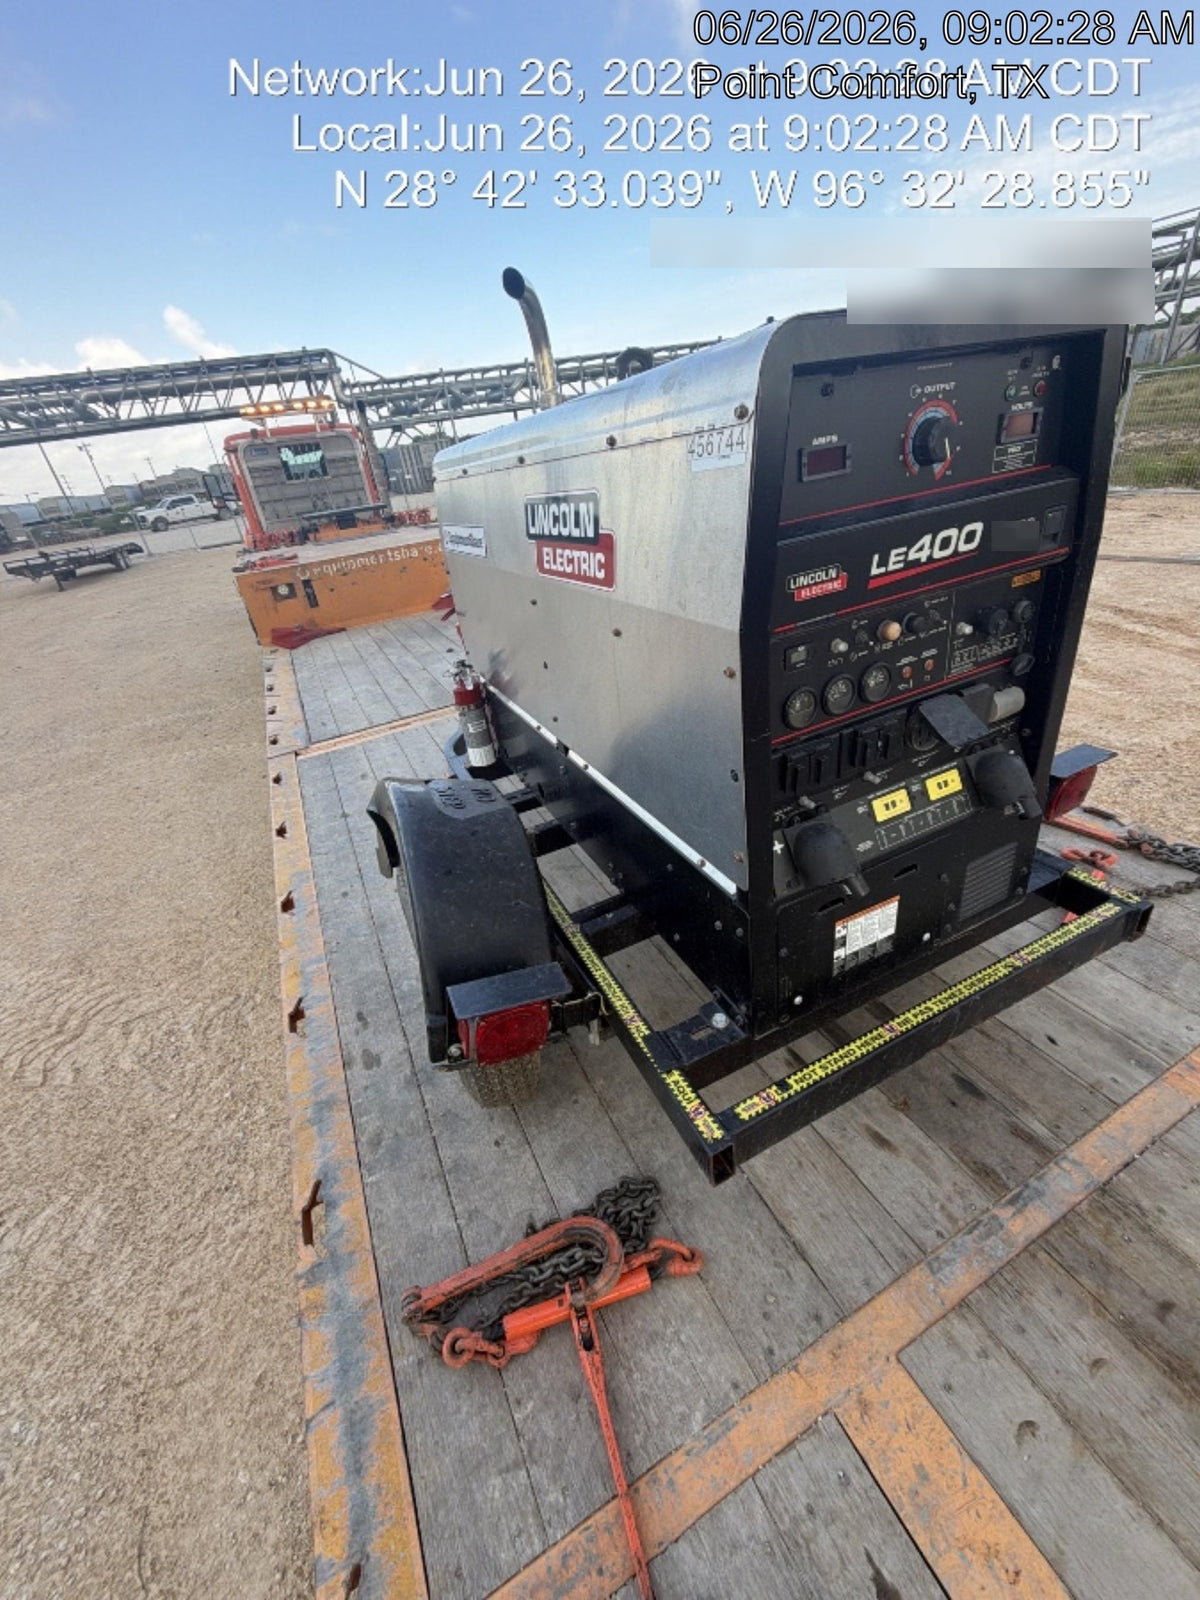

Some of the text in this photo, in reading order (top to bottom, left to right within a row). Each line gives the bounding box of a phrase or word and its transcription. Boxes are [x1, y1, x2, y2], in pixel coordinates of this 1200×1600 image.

[923, 382, 957, 394] OUTPUT
[687, 426, 746, 458] 456744
[527, 501, 595, 538] LINCOLN
[542, 546, 606, 579] ELECTRIC
[870, 521, 984, 576] LE400
[789, 567, 839, 589] LINCOLN
[800, 580, 843, 599] ELECTRIC
[792, 1067, 819, 1086] NOT
[818, 1047, 857, 1073] STAND
